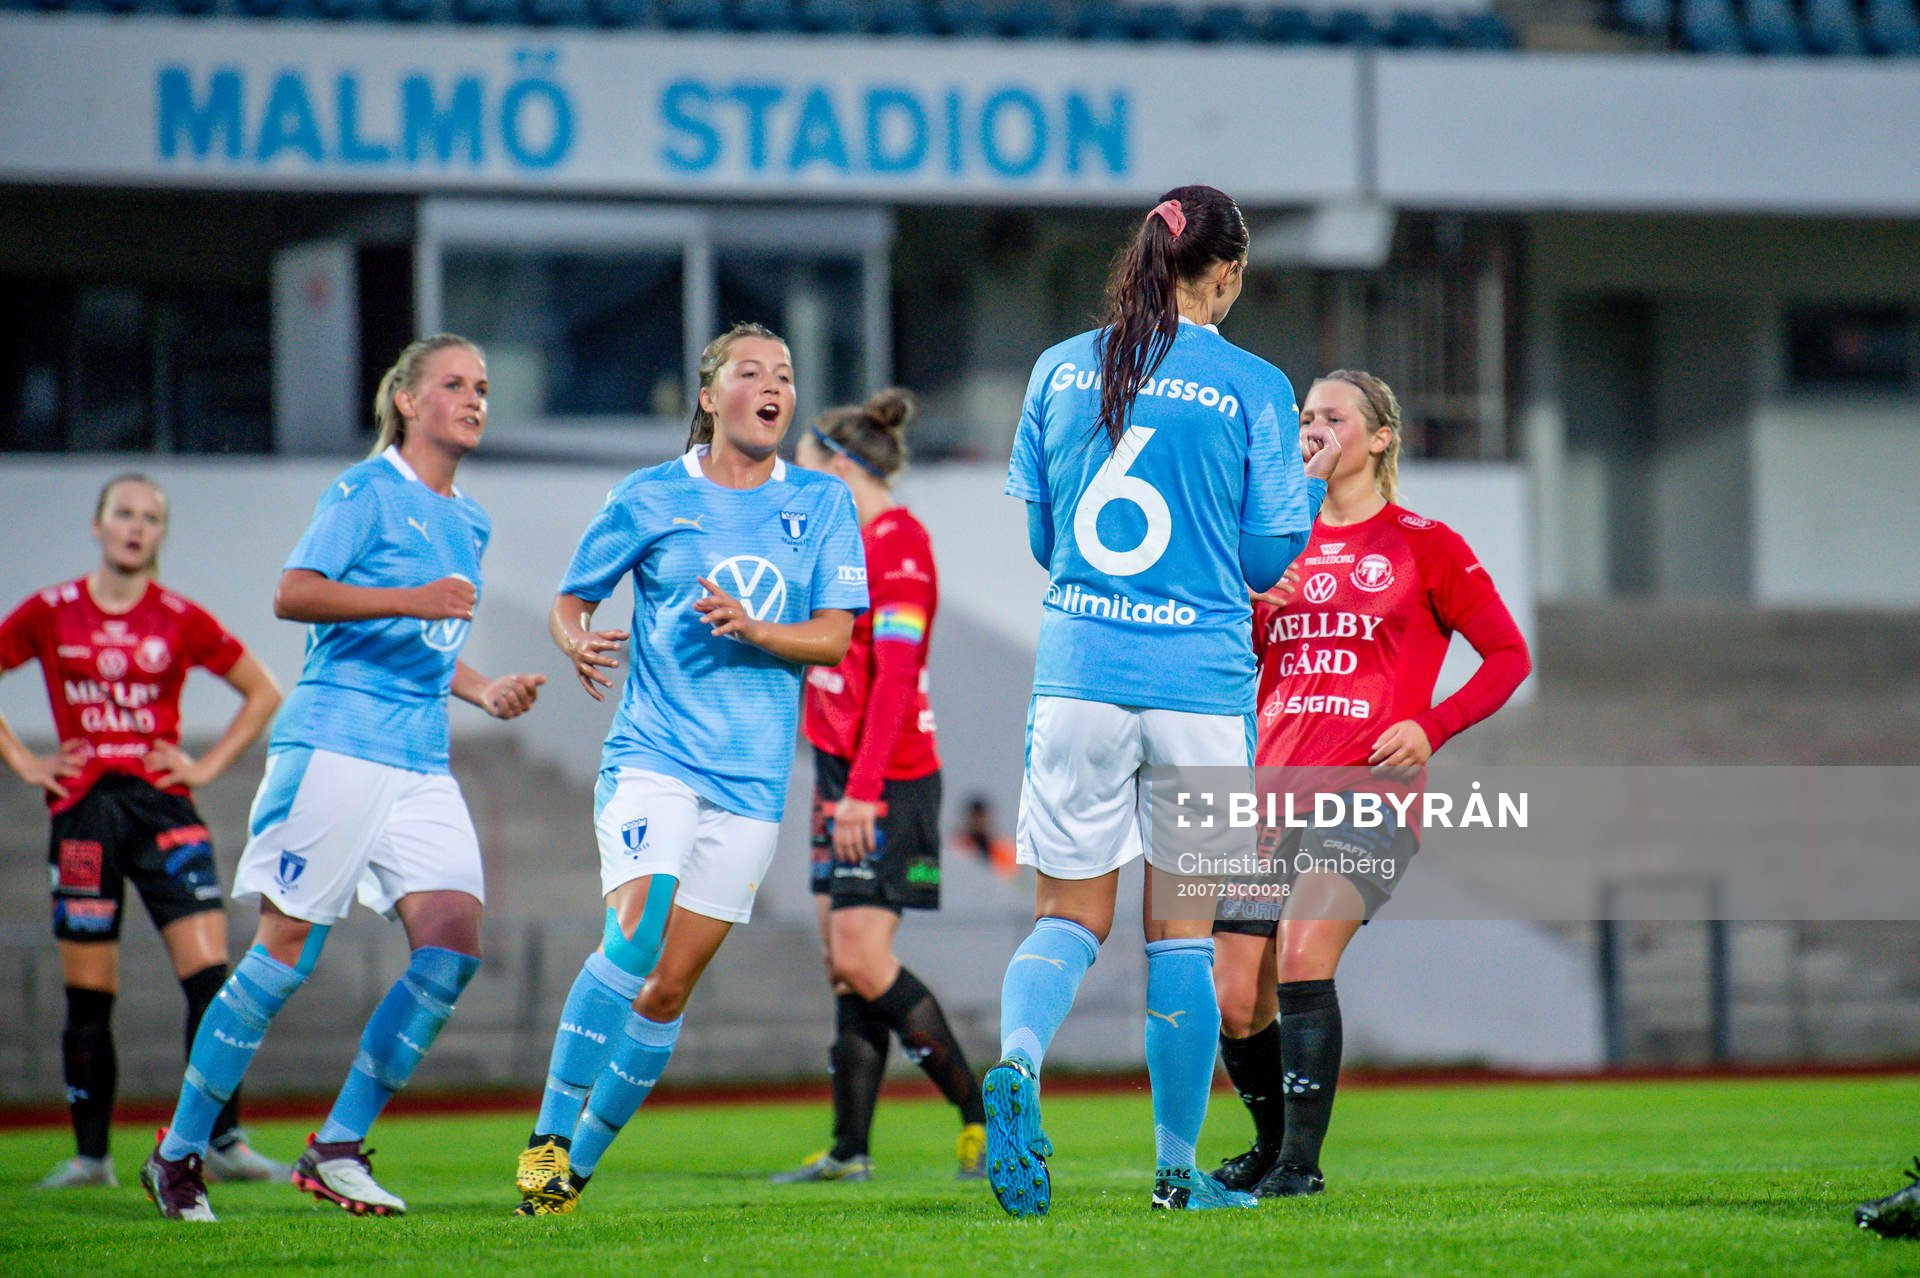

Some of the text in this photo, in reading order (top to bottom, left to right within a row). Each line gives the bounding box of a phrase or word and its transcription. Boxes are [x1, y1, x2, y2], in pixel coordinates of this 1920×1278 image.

[155, 47, 1130, 178] MALMÖ STADION
[1050, 362, 1239, 418] Guarsson
[1073, 424, 1172, 576] 6
[1266, 611, 1384, 645] MELLBY
[1280, 642, 1358, 678] GÅRD
